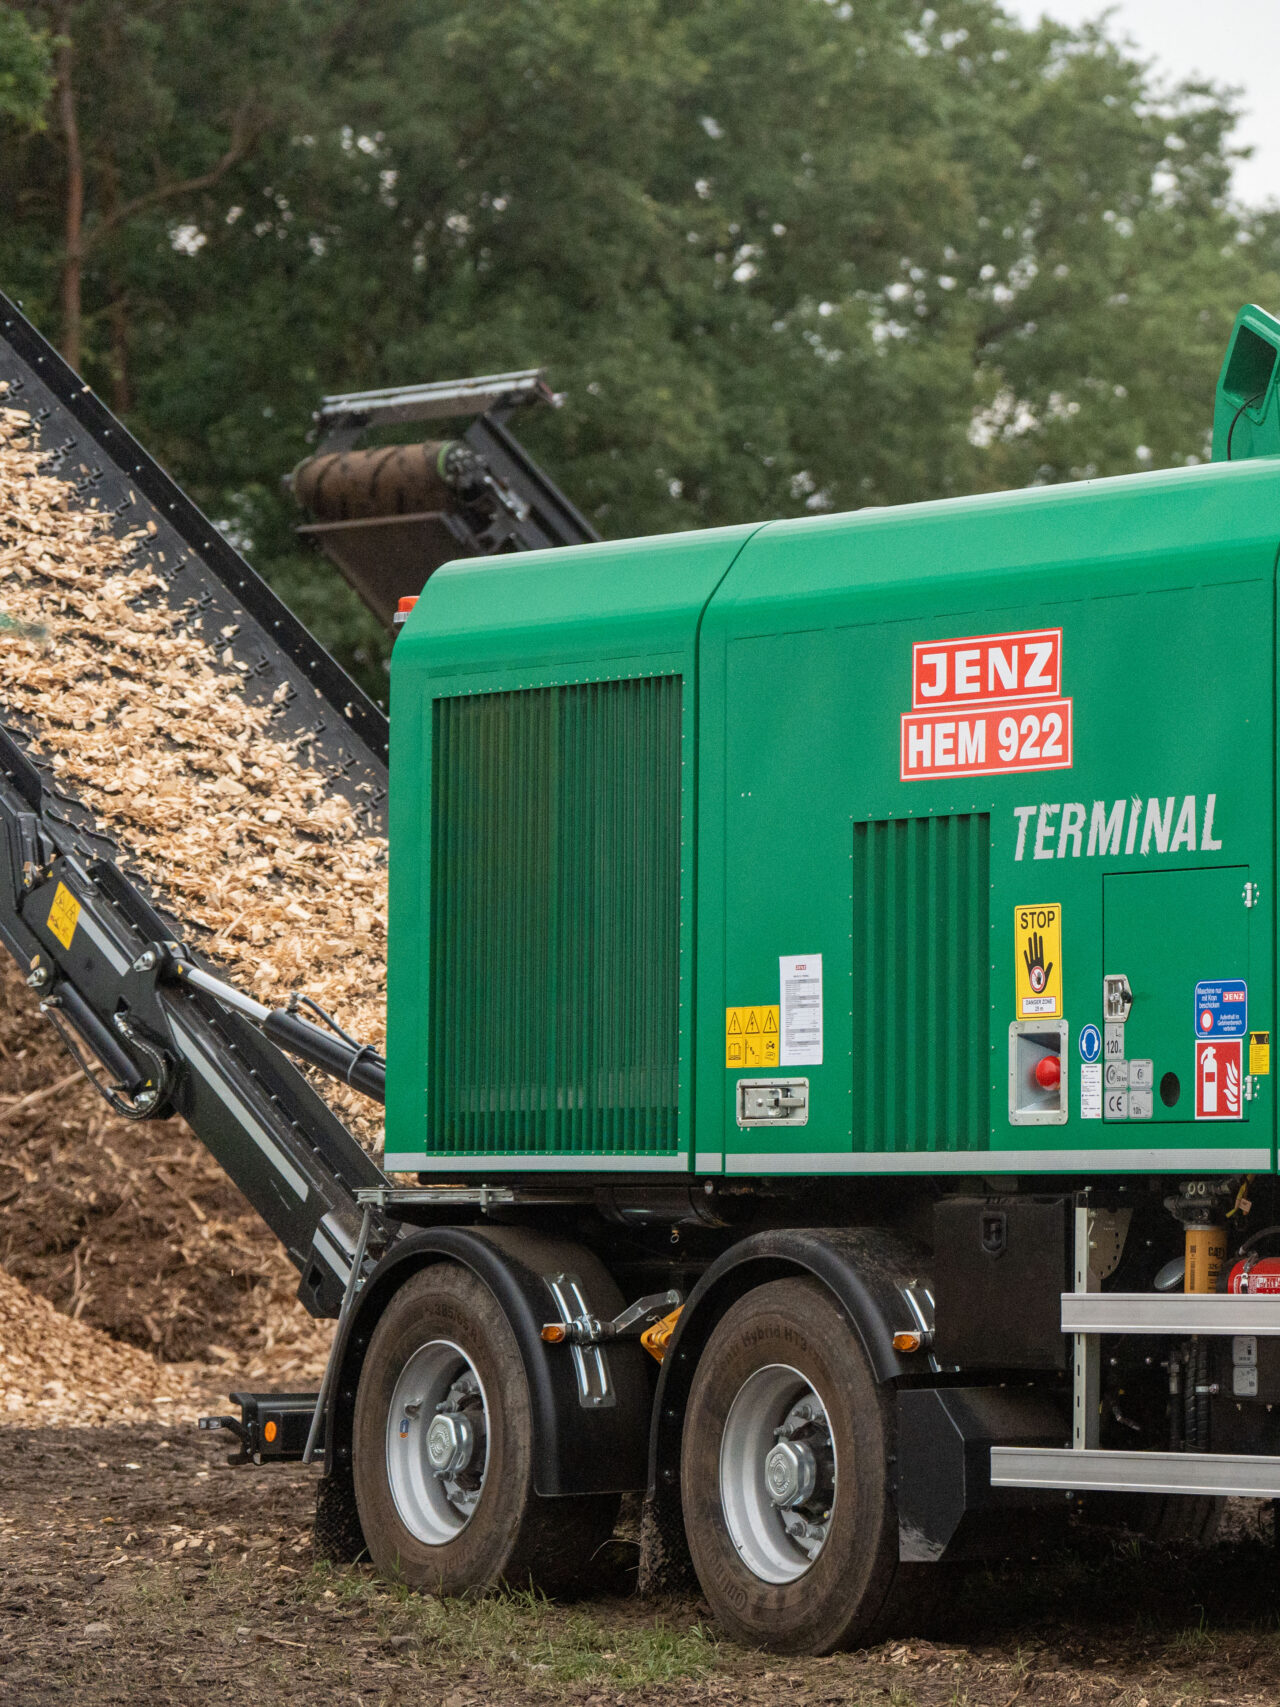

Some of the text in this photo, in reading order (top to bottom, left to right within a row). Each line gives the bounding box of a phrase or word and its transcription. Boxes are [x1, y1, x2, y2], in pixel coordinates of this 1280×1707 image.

[920, 641, 1053, 697] JENZ
[908, 713, 1063, 768] HEM 922
[1013, 793, 1223, 862] TERMINAL
[1020, 910, 1056, 930] STOP
[1224, 993, 1244, 1001] JENZ
[1106, 1040, 1119, 1054] 120
[1109, 1096, 1122, 1112] CE
[740, 1324, 781, 1348] Hybrid
